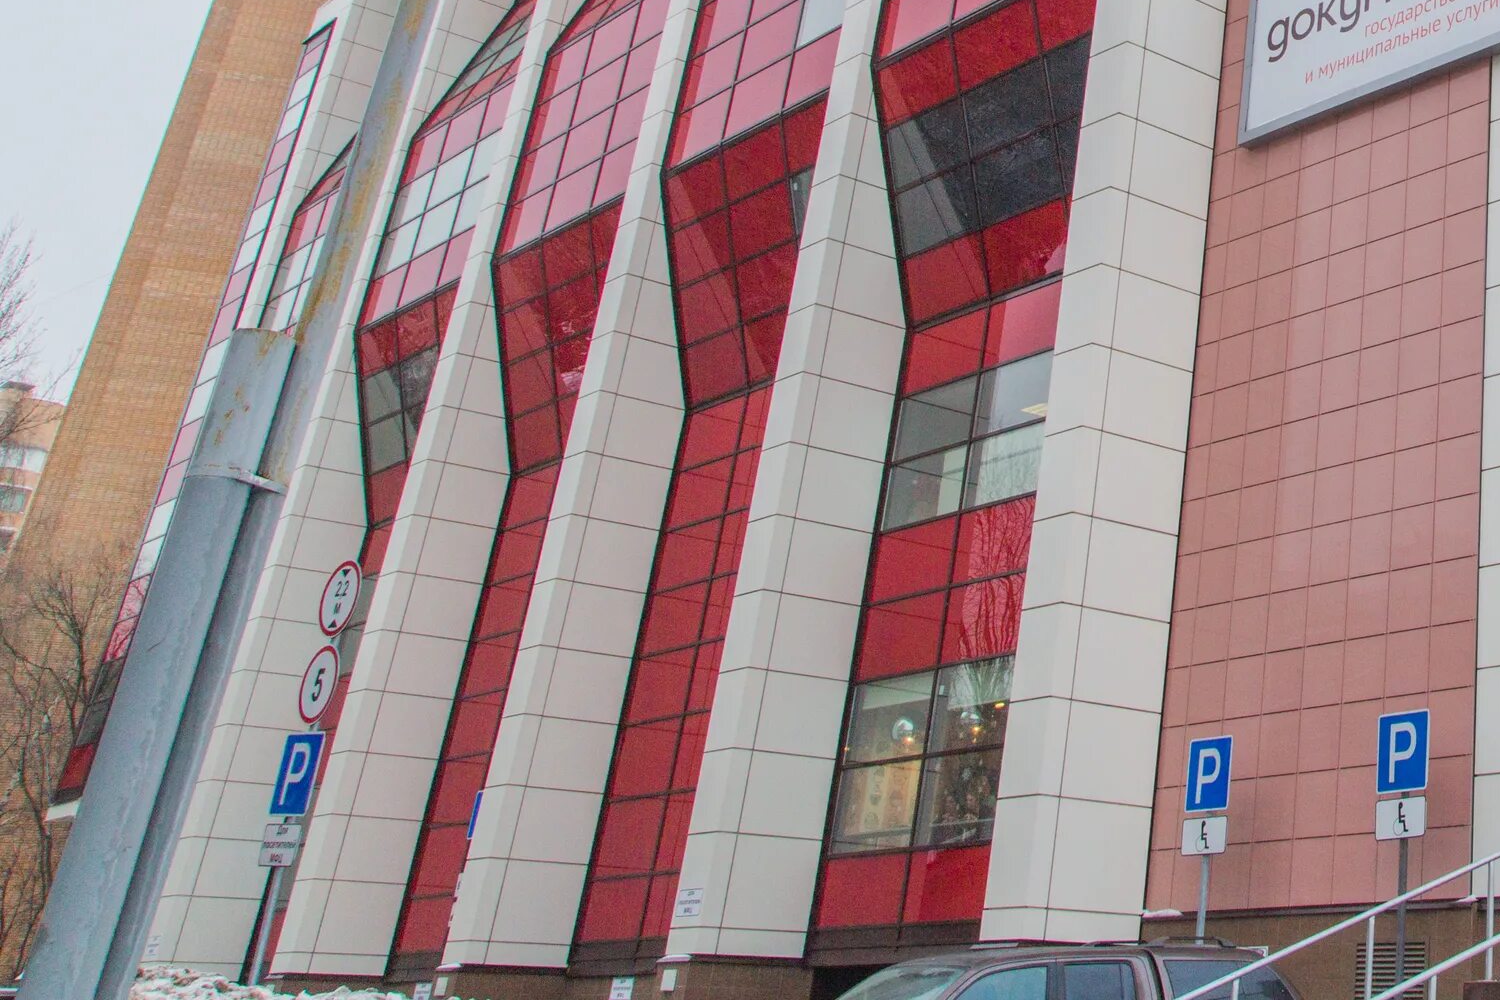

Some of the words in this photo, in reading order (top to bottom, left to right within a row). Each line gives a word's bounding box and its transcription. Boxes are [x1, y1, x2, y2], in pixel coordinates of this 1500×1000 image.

[1304, 72, 1313, 85] и
[1318, 18, 1442, 78] муниципальные
[312, 668, 326, 702] 5
[278, 742, 310, 806] P
[1195, 747, 1221, 804] P
[1389, 721, 1417, 783] P
